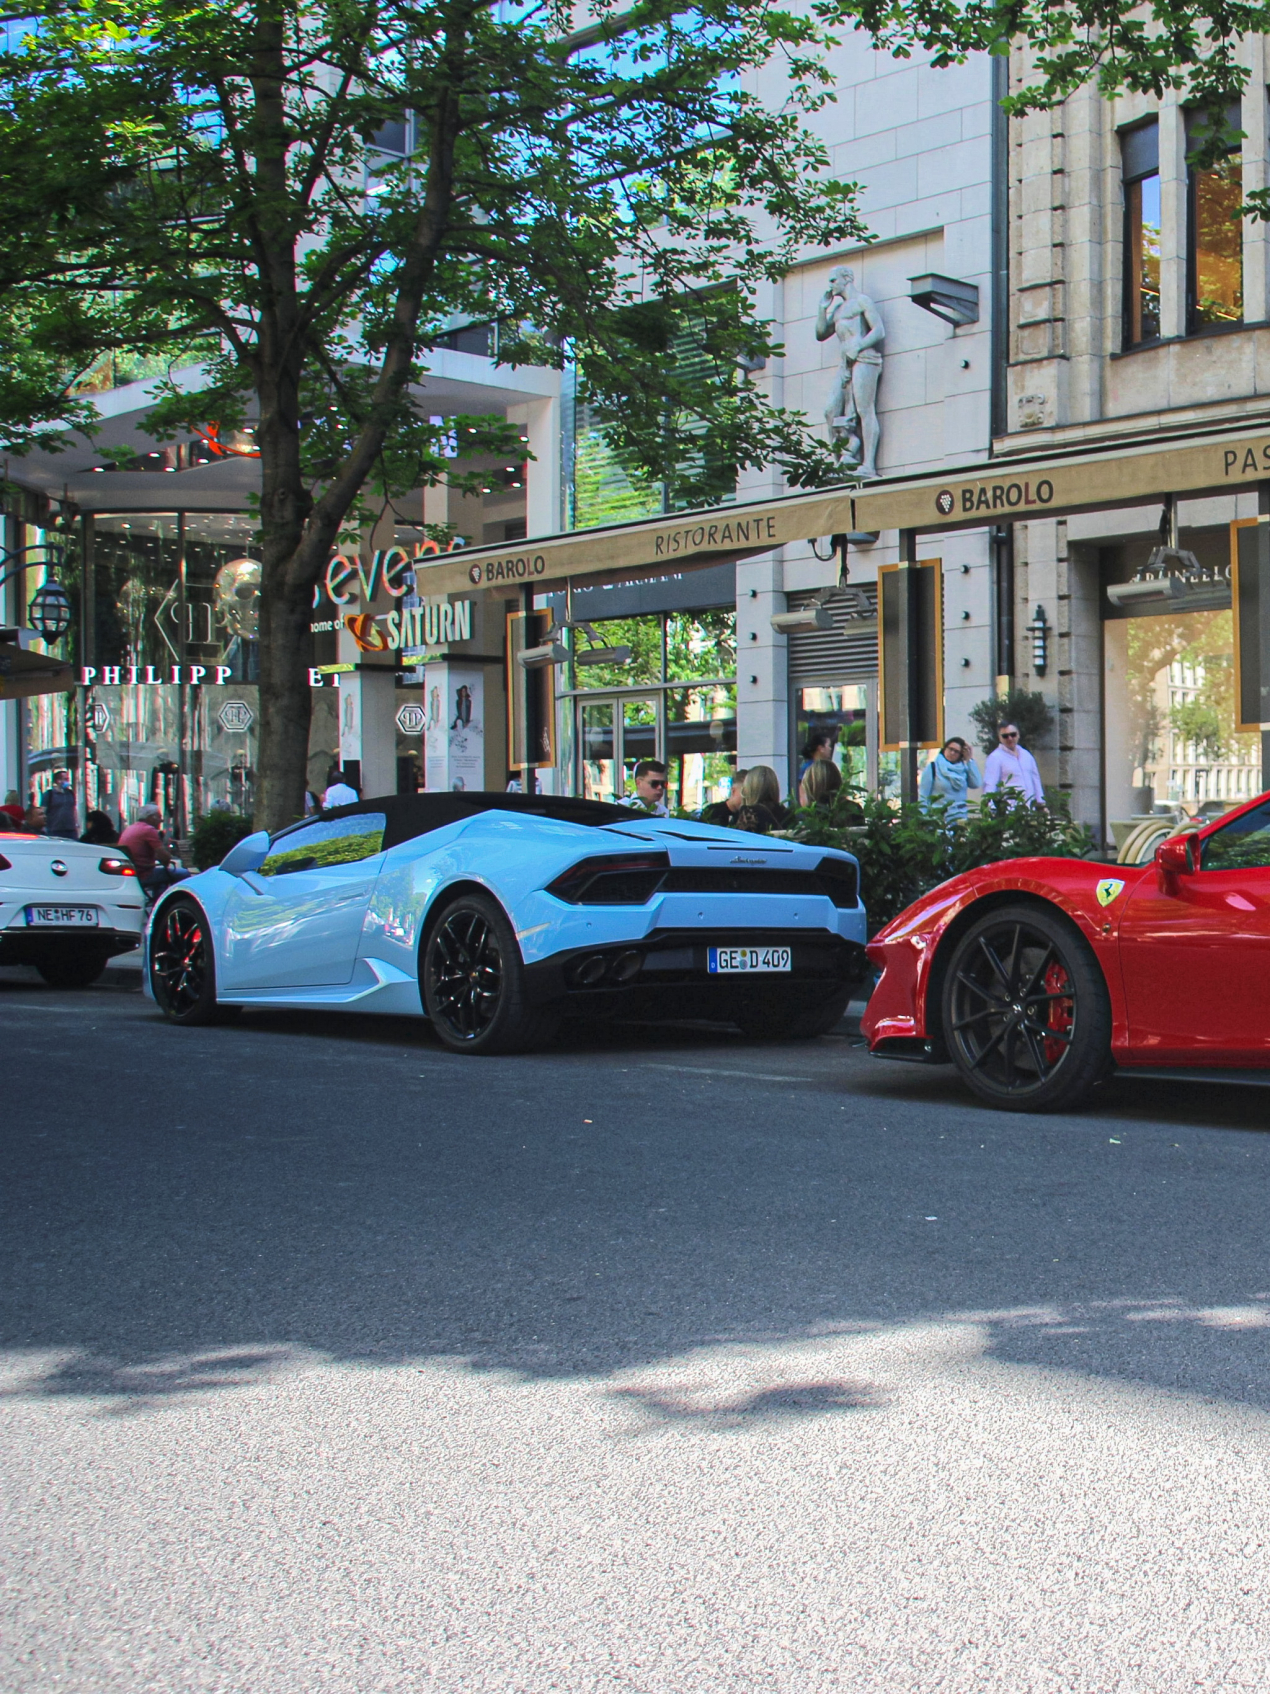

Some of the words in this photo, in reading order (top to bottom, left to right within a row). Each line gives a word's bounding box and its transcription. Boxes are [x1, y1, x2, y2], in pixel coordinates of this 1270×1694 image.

[961, 478, 1054, 512] BAROLO
[654, 516, 777, 557] RISTORANTE
[485, 555, 545, 582] BAROLO
[334, 612, 345, 629] of
[386, 599, 471, 650] SATURN
[82, 665, 232, 686] PHILIPP
[37, 908, 54, 921] NE
[60, 909, 76, 921] HF
[78, 909, 93, 922] 76
[719, 950, 739, 969] GE
[749, 950, 759, 969] D
[762, 949, 790, 968] 409
